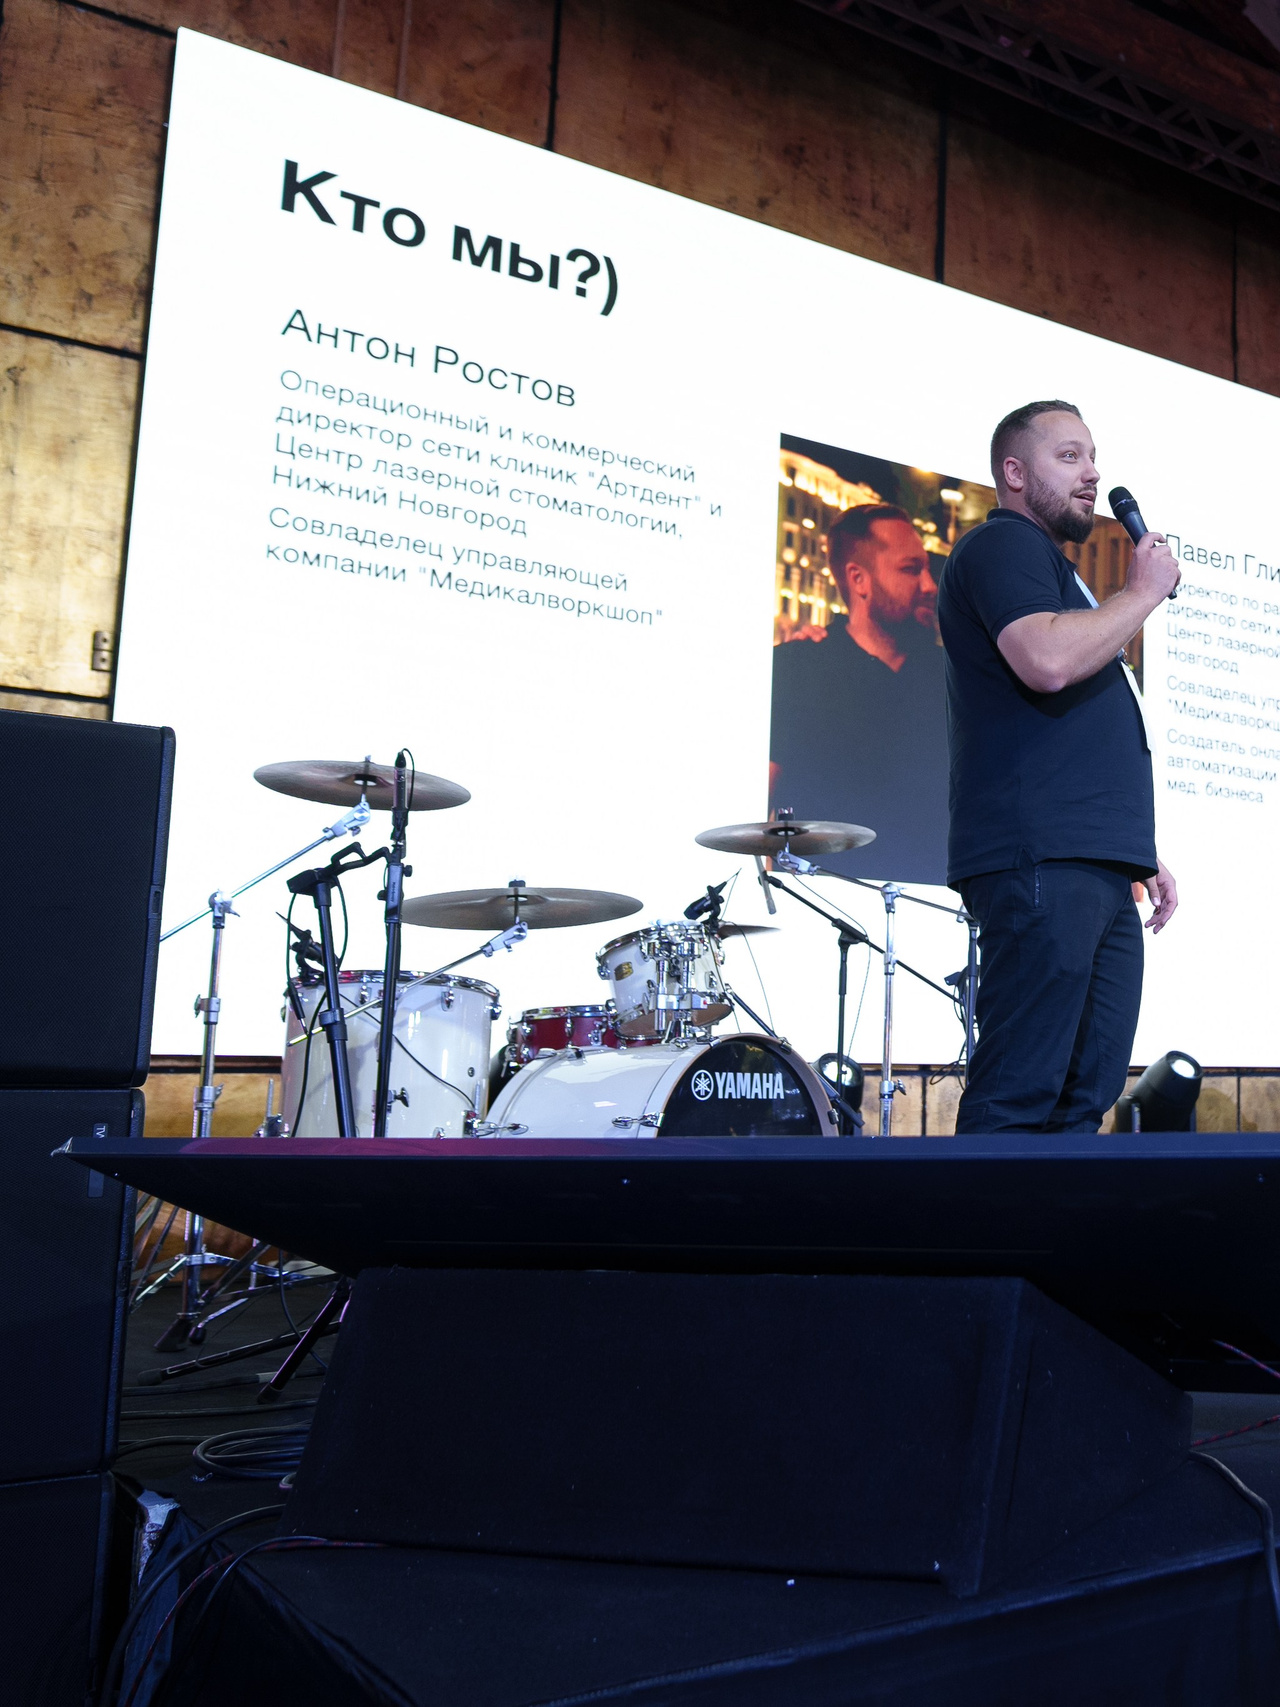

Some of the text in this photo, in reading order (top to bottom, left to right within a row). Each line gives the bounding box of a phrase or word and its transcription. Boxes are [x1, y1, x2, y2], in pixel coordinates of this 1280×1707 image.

[280, 159, 618, 317] Кто мы?)
[281, 309, 575, 407] Антон Ростов
[280, 370, 694, 483] Операционный и коммерческий
[276, 406, 722, 517] директор сети клиник "Артдент" и
[273, 465, 528, 538] Нижний Новгород
[275, 433, 682, 539] Центр лазерной стоматологии,
[269, 507, 628, 591] Совладелец управляющей
[1166, 534, 1235, 571] Павел
[266, 544, 662, 625] компании "Медикалворкшоп"
[1167, 602, 1236, 627] директор
[1240, 616, 1271, 634] сети
[1243, 597, 1259, 610] по
[1167, 622, 1212, 646] Центр
[1167, 646, 1239, 675] Новгород
[1167, 675, 1256, 707] Совладелец
[1167, 728, 1246, 755] Создатель
[1167, 755, 1277, 782] автоматизации
[1167, 779, 1264, 804] мед. бизнеса
[714, 1071, 785, 1100] YAMAHA
